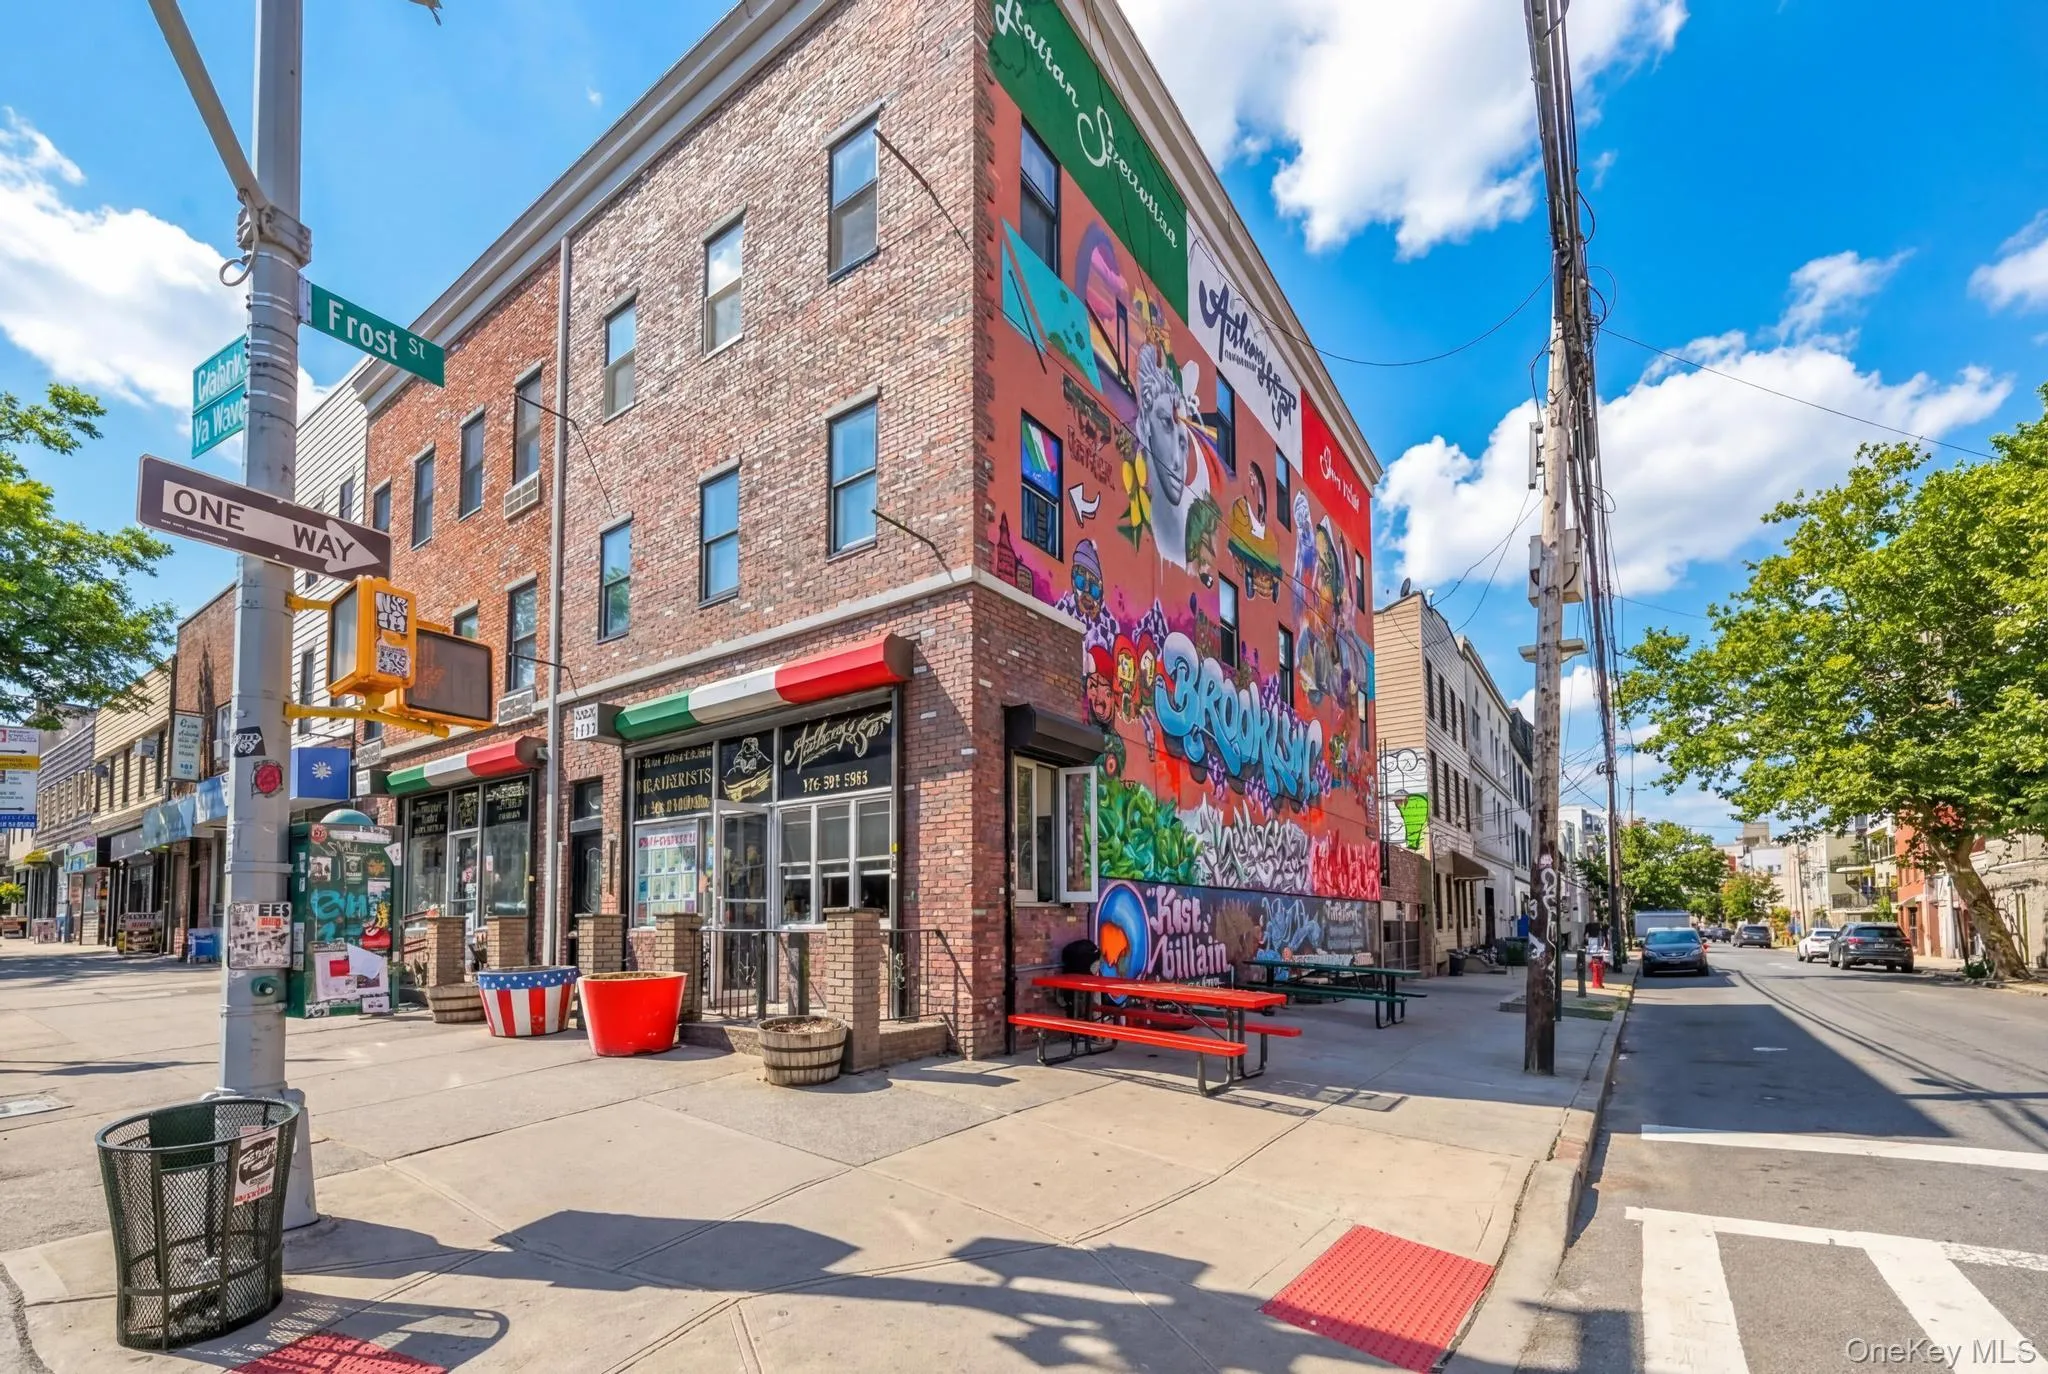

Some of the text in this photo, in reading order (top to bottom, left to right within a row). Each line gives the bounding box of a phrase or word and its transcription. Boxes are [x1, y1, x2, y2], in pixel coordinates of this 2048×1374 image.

[328, 298, 425, 361] Frost St
[173, 488, 245, 532] ONE
[292, 524, 355, 563] WAY
